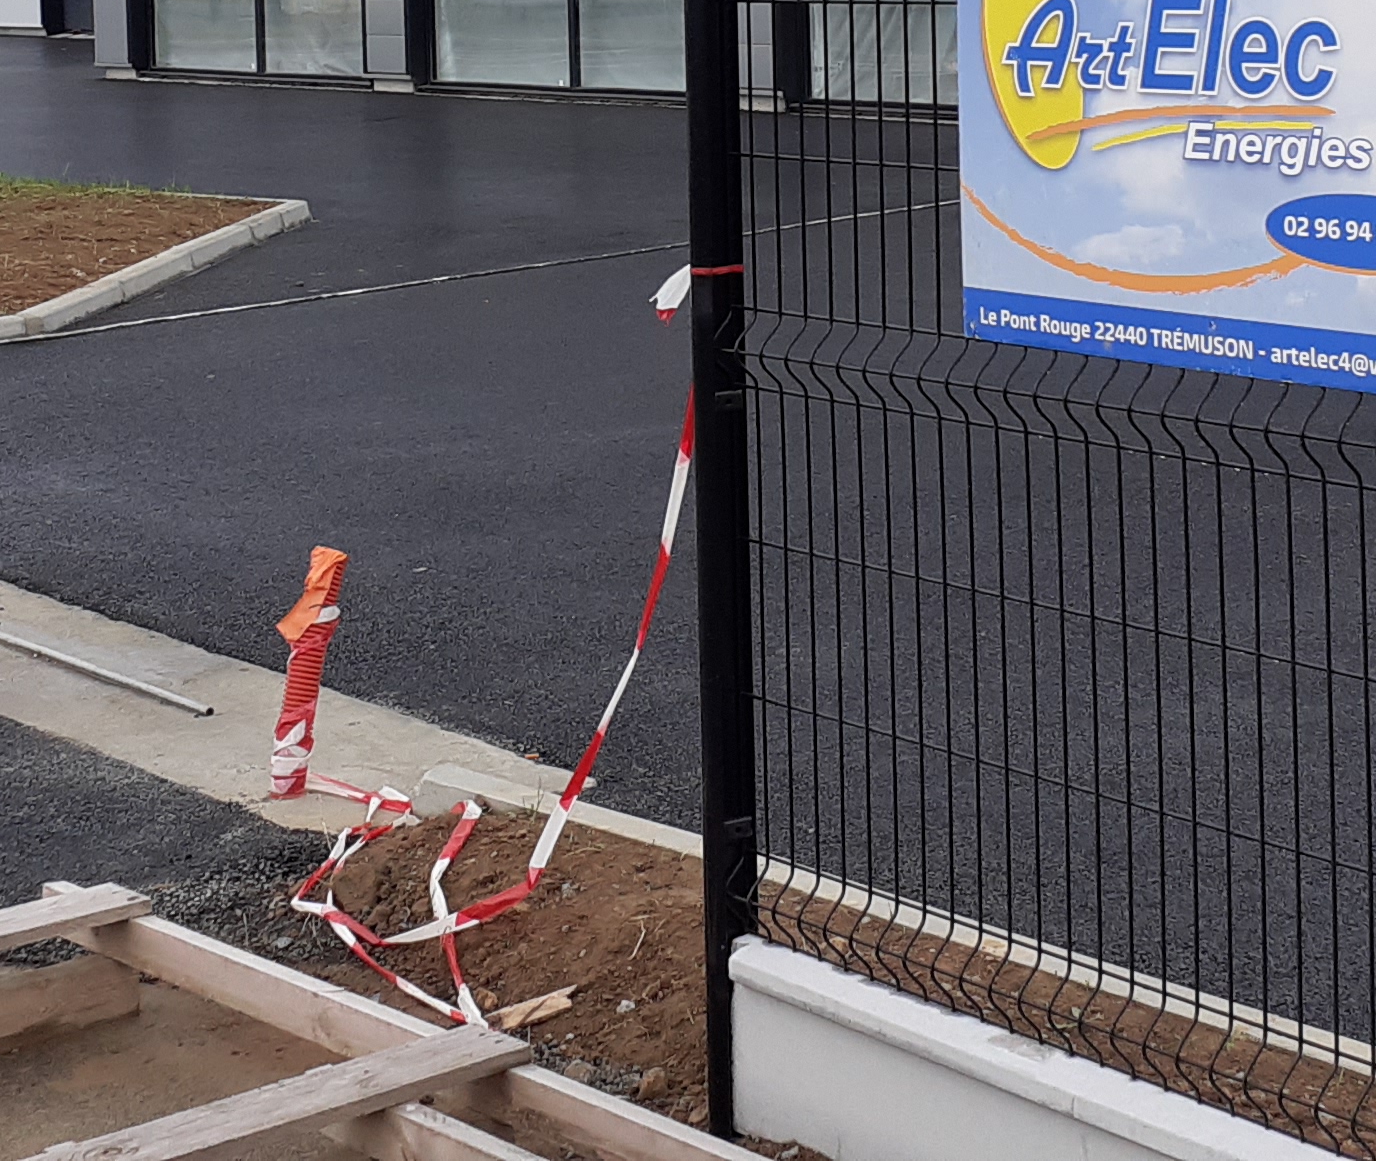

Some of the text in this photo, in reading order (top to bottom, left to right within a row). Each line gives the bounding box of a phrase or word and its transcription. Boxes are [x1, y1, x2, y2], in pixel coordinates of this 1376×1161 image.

[1183, 120, 1373, 176] Energies
[1284, 215, 1309, 237] 02
[1314, 218, 1341, 239] 96
[1345, 220, 1373, 242] 94
[979, 306, 997, 326] Le
[1001, 309, 1036, 331] Pont
[1040, 314, 1091, 343] Rouge
[1094, 321, 1147, 346] 22440
[1150, 327, 1254, 360] TRÉMUSON
